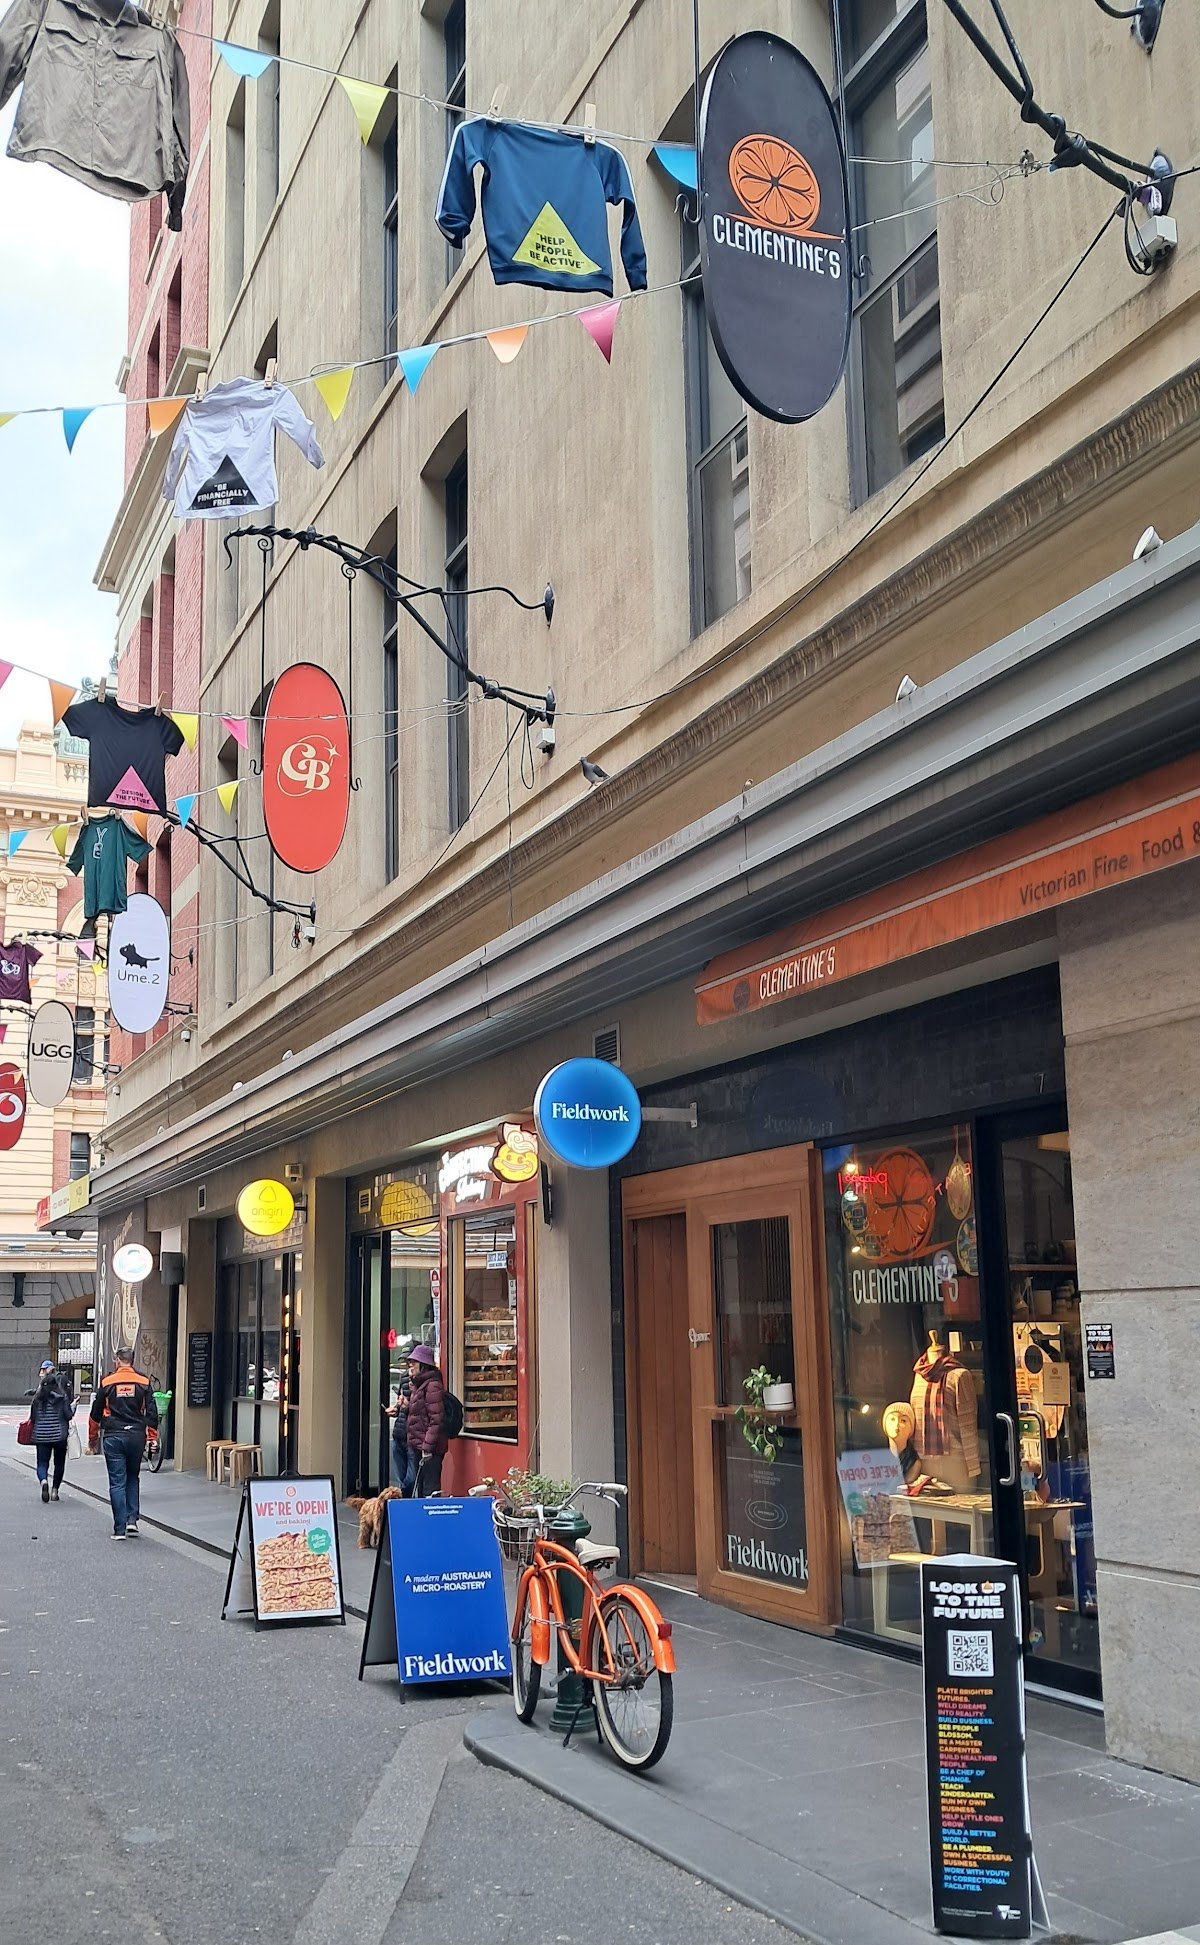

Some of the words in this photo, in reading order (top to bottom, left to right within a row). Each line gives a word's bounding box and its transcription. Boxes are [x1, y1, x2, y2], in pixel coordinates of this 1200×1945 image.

[535, 242, 573, 257] PEOPLE
[713, 214, 841, 279] CLEMENTINE'S
[529, 250, 541, 260] BE
[197, 489, 249, 503] FINANCIALLY
[1019, 868, 1087, 906] Victorian
[1094, 853, 1129, 879] Fine
[1141, 826, 1184, 863] Food
[117, 969, 160, 985] Ume.2
[759, 946, 836, 1000] CLEMENTINE'S
[31, 1042, 72, 1058] UGG
[552, 1102, 629, 1122] Fieldwork
[255, 1501, 292, 1517] WE'RE
[295, 1500, 329, 1515] OPEN!
[275, 1518, 288, 1526] and
[727, 1534, 809, 1580] Fieldwork
[405, 1575, 412, 1583] A
[413, 1573, 440, 1583] modern
[441, 1570, 492, 1582] AUSTRALIAN
[412, 1581, 486, 1593] MICRO-ROASTERY
[929, 1581, 978, 1594] LOOK
[981, 1580, 1006, 1594] UP
[935, 1594, 961, 1606] TO
[964, 1595, 1001, 1607] THE
[933, 1606, 1005, 1619] FUTURE
[405, 1649, 507, 1678] Fieldwork
[952, 1724, 980, 1732] PEOPLE
[984, 1815, 1004, 1823] ONES
[942, 1828, 962, 1836] BUILD
[968, 1853, 1013, 1861] SUCCESSFUL
[944, 1867, 965, 1875] WORK
[966, 1868, 984, 1876] WITH
[985, 1869, 1010, 1877] YOUTH
[953, 1875, 1007, 1885] CORRECTIONAL
